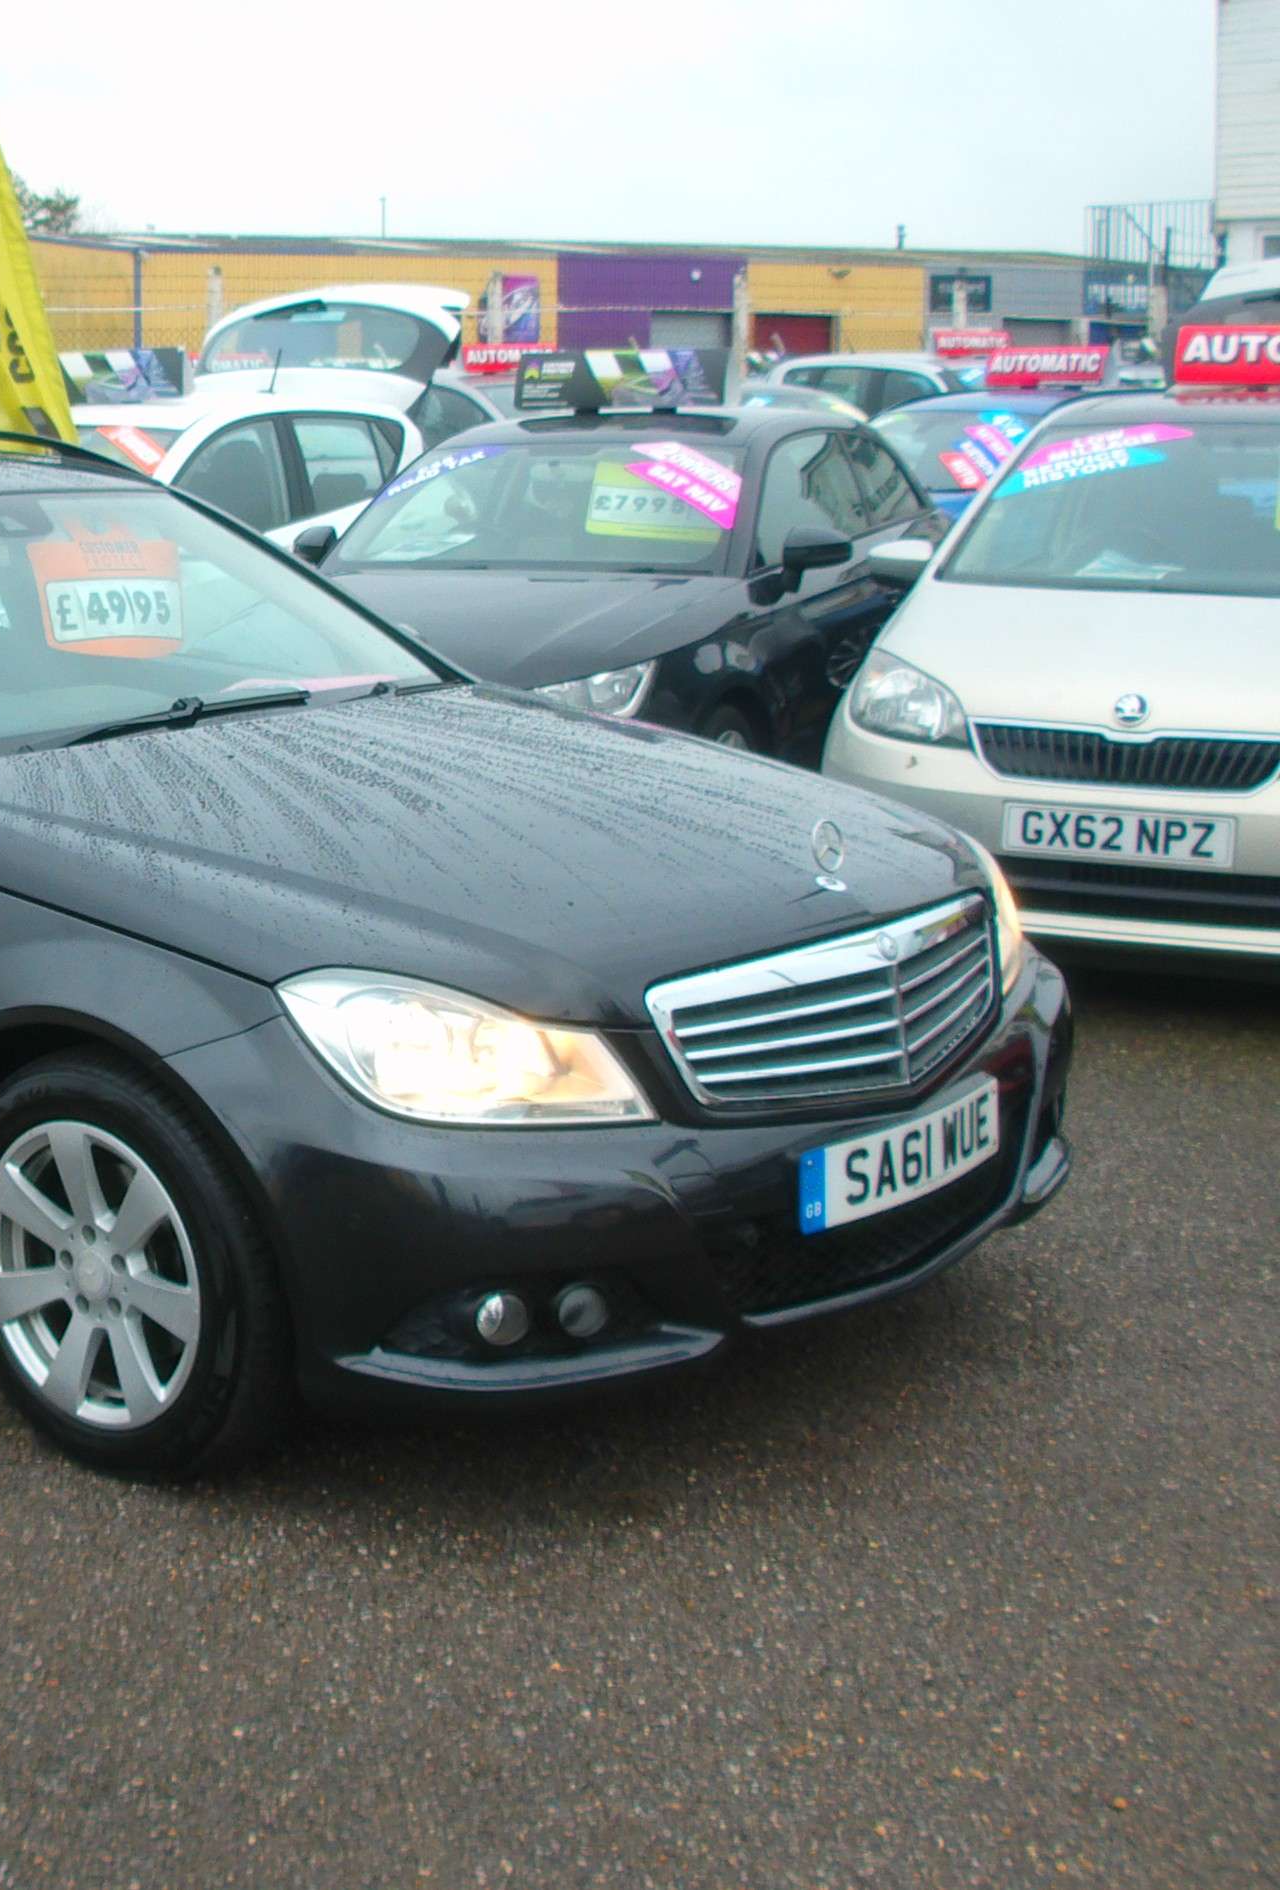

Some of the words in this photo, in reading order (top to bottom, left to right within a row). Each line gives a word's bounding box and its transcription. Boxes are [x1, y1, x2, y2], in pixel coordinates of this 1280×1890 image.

[937, 335, 1008, 350] AUTOMATIC
[991, 353, 1102, 374] AUTOMATIC
[56, 590, 171, 631] £4995
[1021, 810, 1124, 851] GX62
[1136, 818, 1216, 858] NPZ
[846, 1123, 933, 1206] SA61
[943, 1091, 989, 1170] WUE
[805, 1201, 823, 1219] GB
